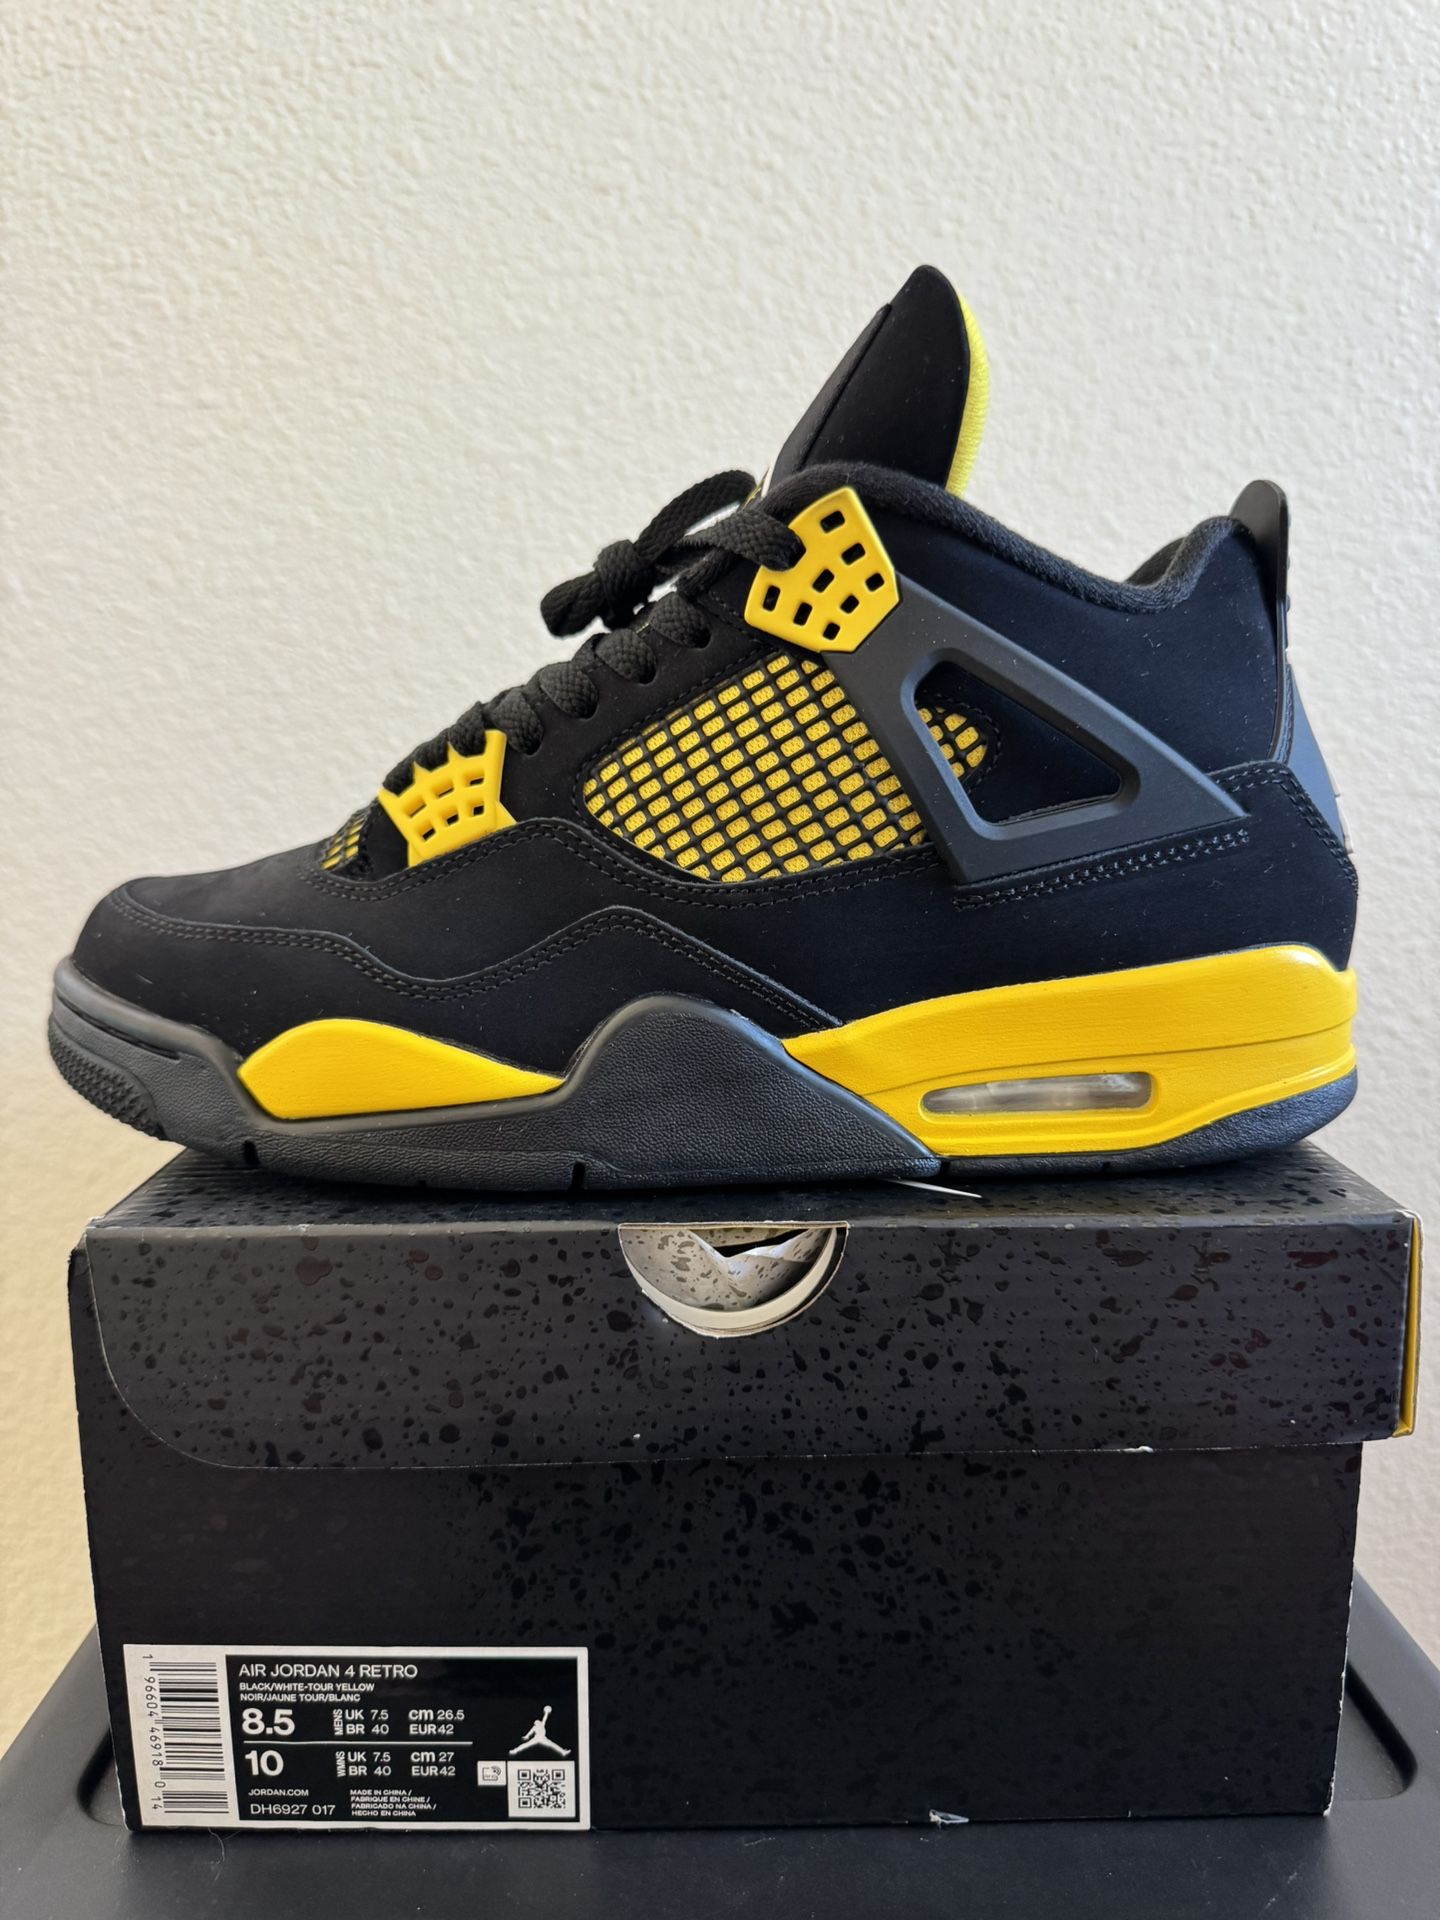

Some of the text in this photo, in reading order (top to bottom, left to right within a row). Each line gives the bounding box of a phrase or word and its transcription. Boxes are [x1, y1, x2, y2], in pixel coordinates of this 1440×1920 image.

[238, 1663, 418, 1678] AIR JORDAN 4 RETRO
[239, 1682, 375, 1692] BLACK/WHITE-TOUR YELLOW
[144, 1676, 159, 1718] 96604
[240, 1693, 361, 1702] NOIR/JAUNE TOUR/BLANC
[345, 1709, 465, 1720] UK 7.5 cm 26.5
[242, 1707, 296, 1736] 8.5
[333, 1708, 344, 1736] MENS
[346, 1724, 365, 1735] BR
[371, 1724, 390, 1735] 40
[149, 1726, 163, 1766] 46918
[348, 1752, 454, 1762] UK 7.5 cm 27
[245, 1749, 284, 1777] 10
[335, 1751, 347, 1778] WMNS
[349, 1766, 368, 1776] BR
[374, 1766, 392, 1776] 40
[248, 1789, 309, 1797] JORDAN.COM
[250, 1804, 336, 1815] DH6927 017
